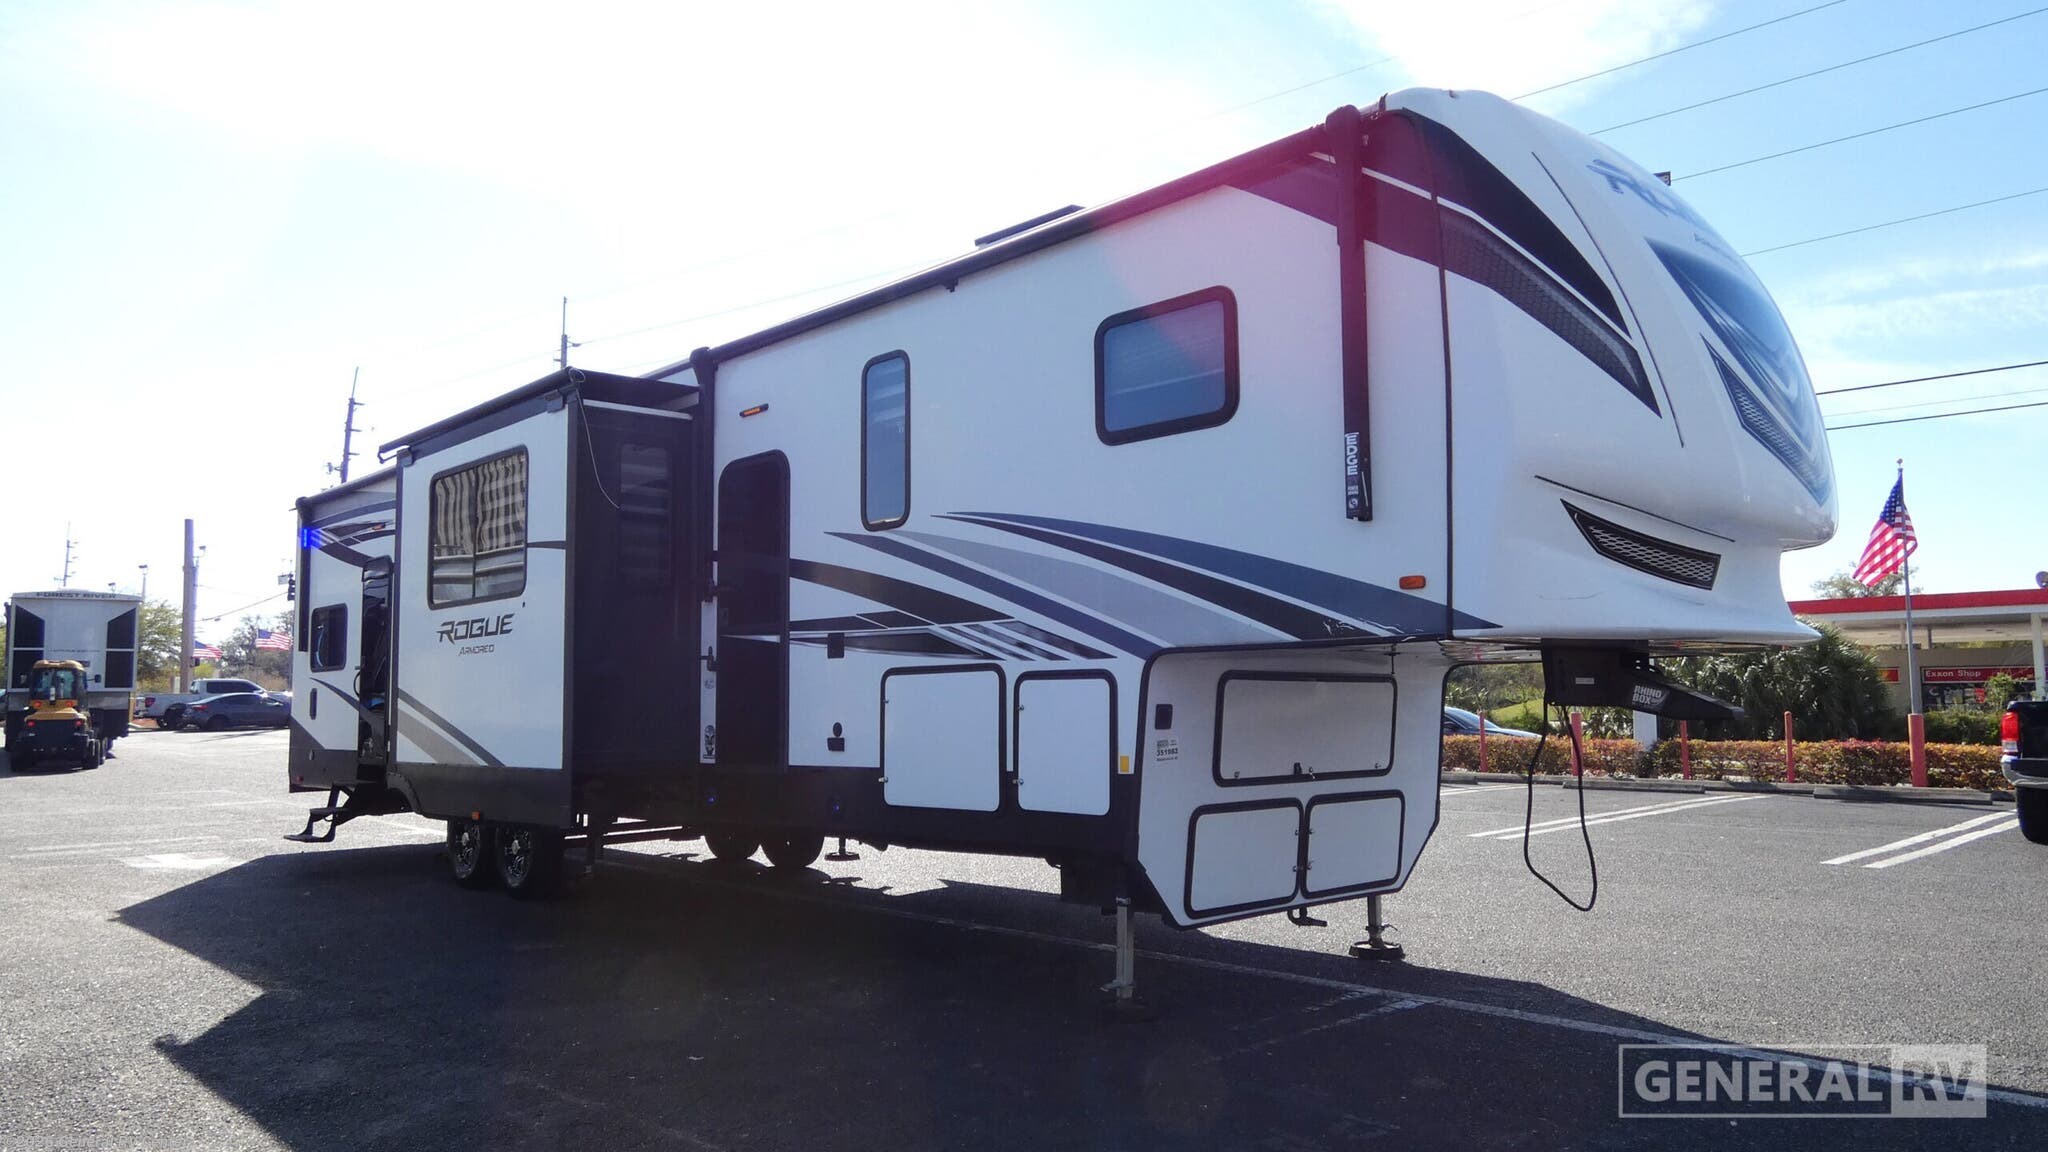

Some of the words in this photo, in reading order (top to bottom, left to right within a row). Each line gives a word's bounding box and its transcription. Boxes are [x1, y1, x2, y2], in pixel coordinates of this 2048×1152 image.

[1345, 433, 1359, 476] EDGE
[436, 613, 515, 645] ROGUE
[458, 644, 495, 656] ARMORED
[1925, 670, 1954, 678] Exxon
[1957, 670, 1982, 678] Shop
[1634, 685, 1661, 698] RHINO
[1632, 694, 1651, 705] BOX
